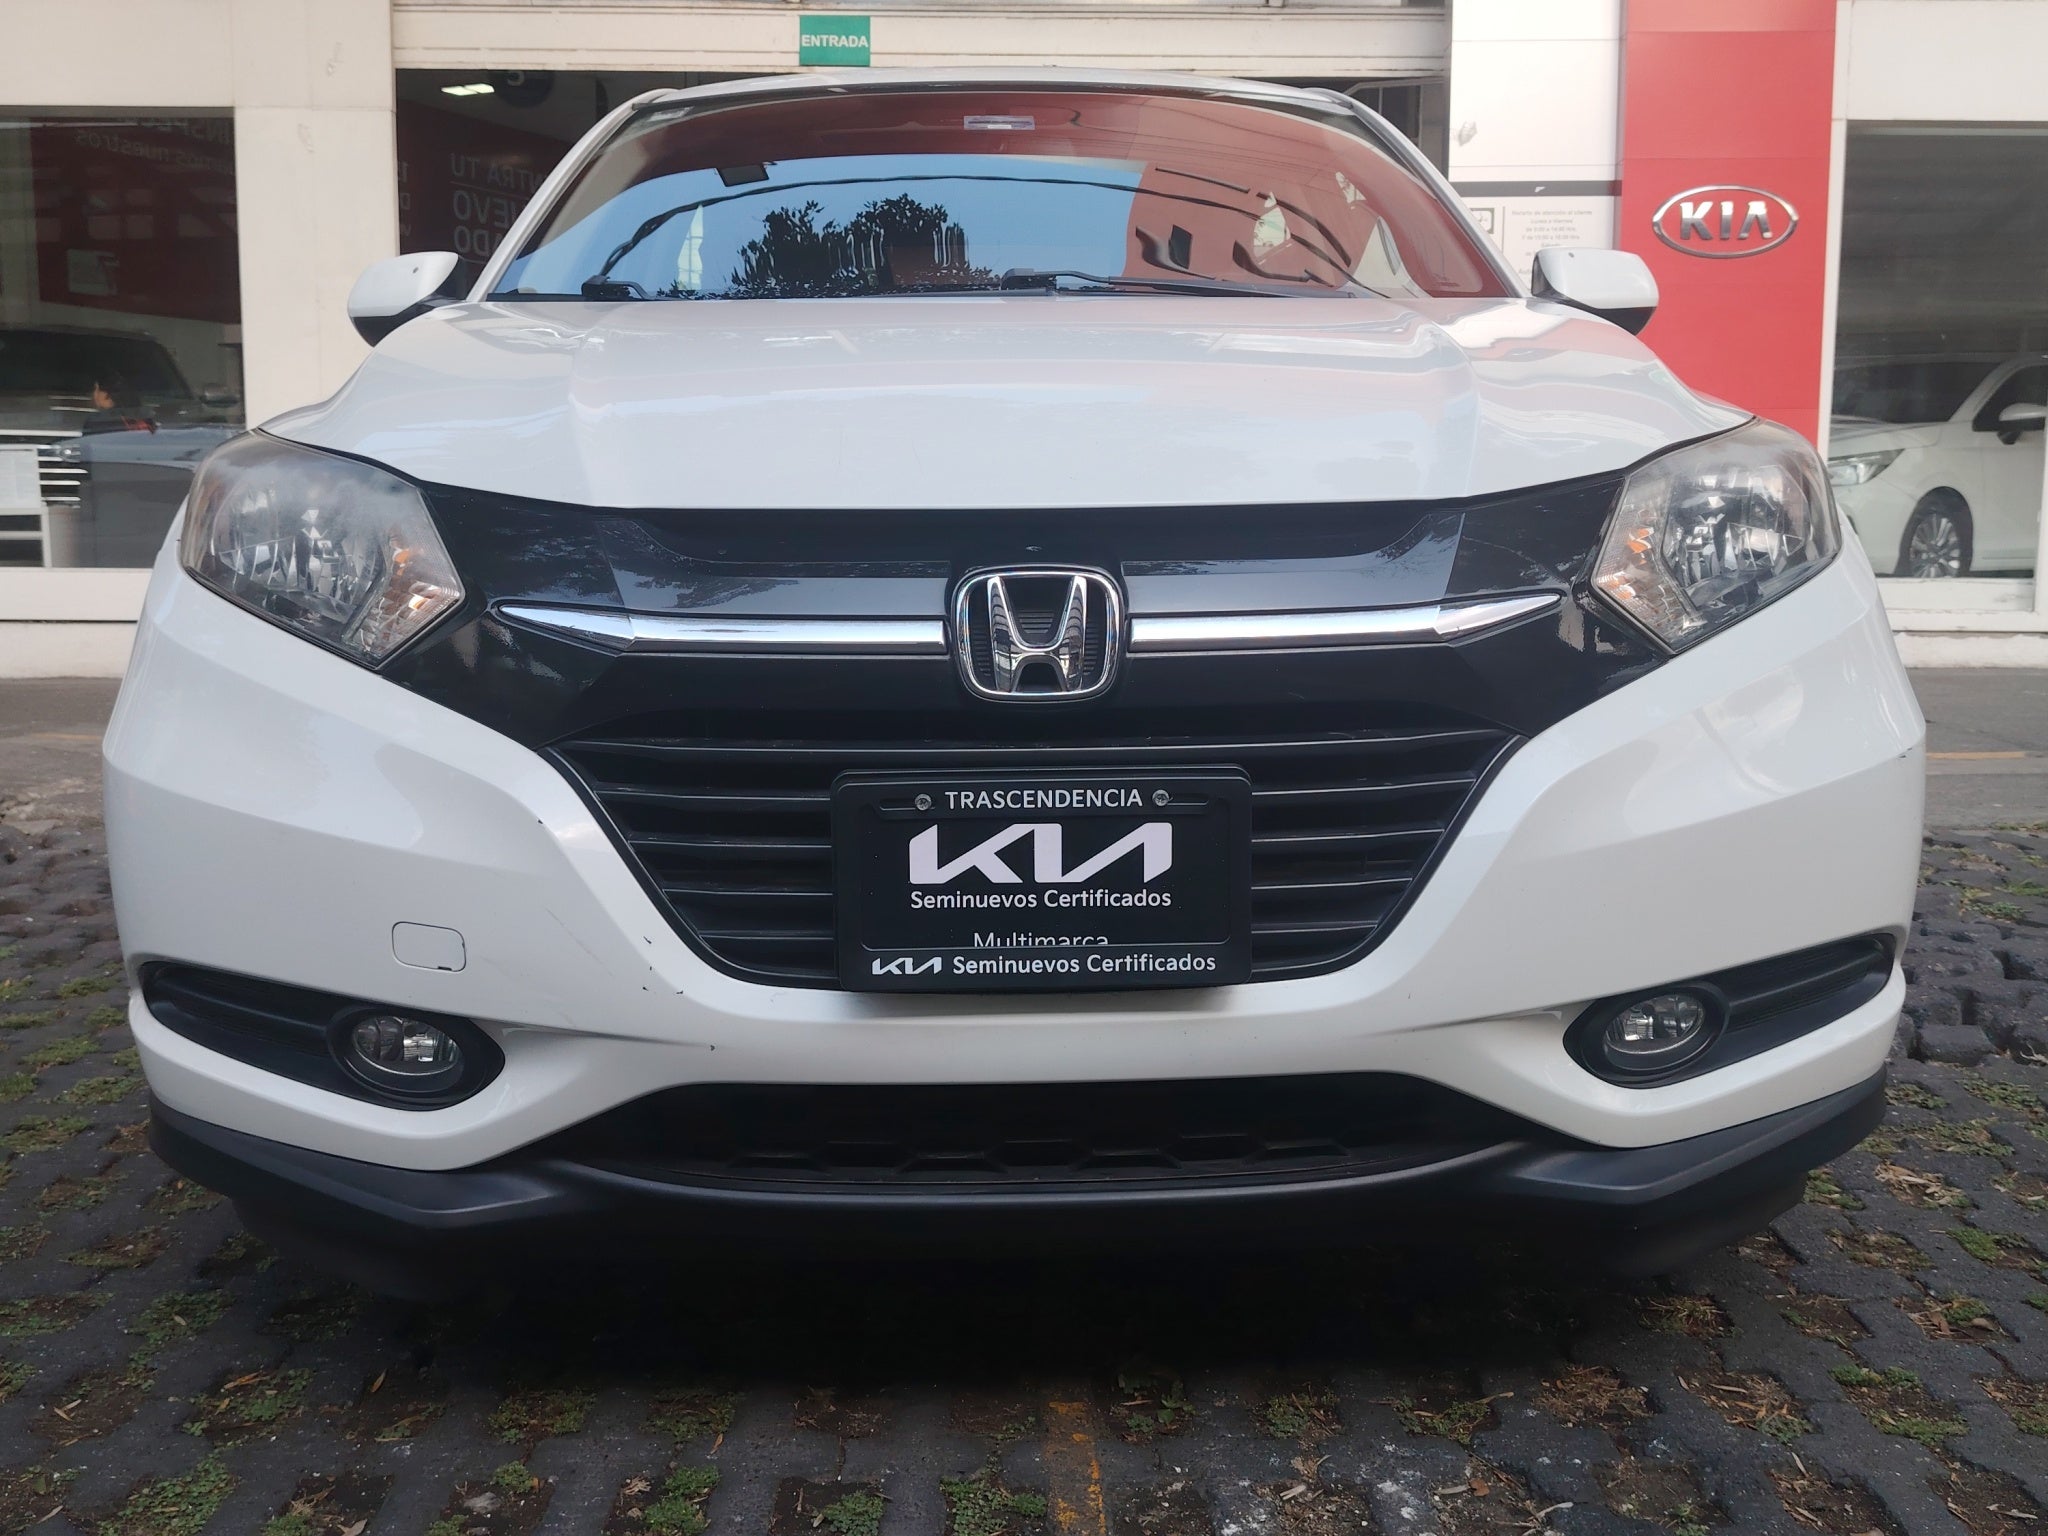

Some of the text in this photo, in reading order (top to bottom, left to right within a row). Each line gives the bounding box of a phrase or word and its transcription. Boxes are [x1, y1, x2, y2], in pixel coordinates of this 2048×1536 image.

[801, 34, 869, 48] ENTRADA
[1680, 201, 1772, 240] KIA
[945, 788, 1143, 810] TRASCENDENCIA
[909, 822, 1173, 885] KIA
[910, 888, 1172, 909] Seminuevos Certificados
[973, 932, 1109, 947] Multimarca
[871, 953, 1217, 976] KIA Seminuevos Certificados
